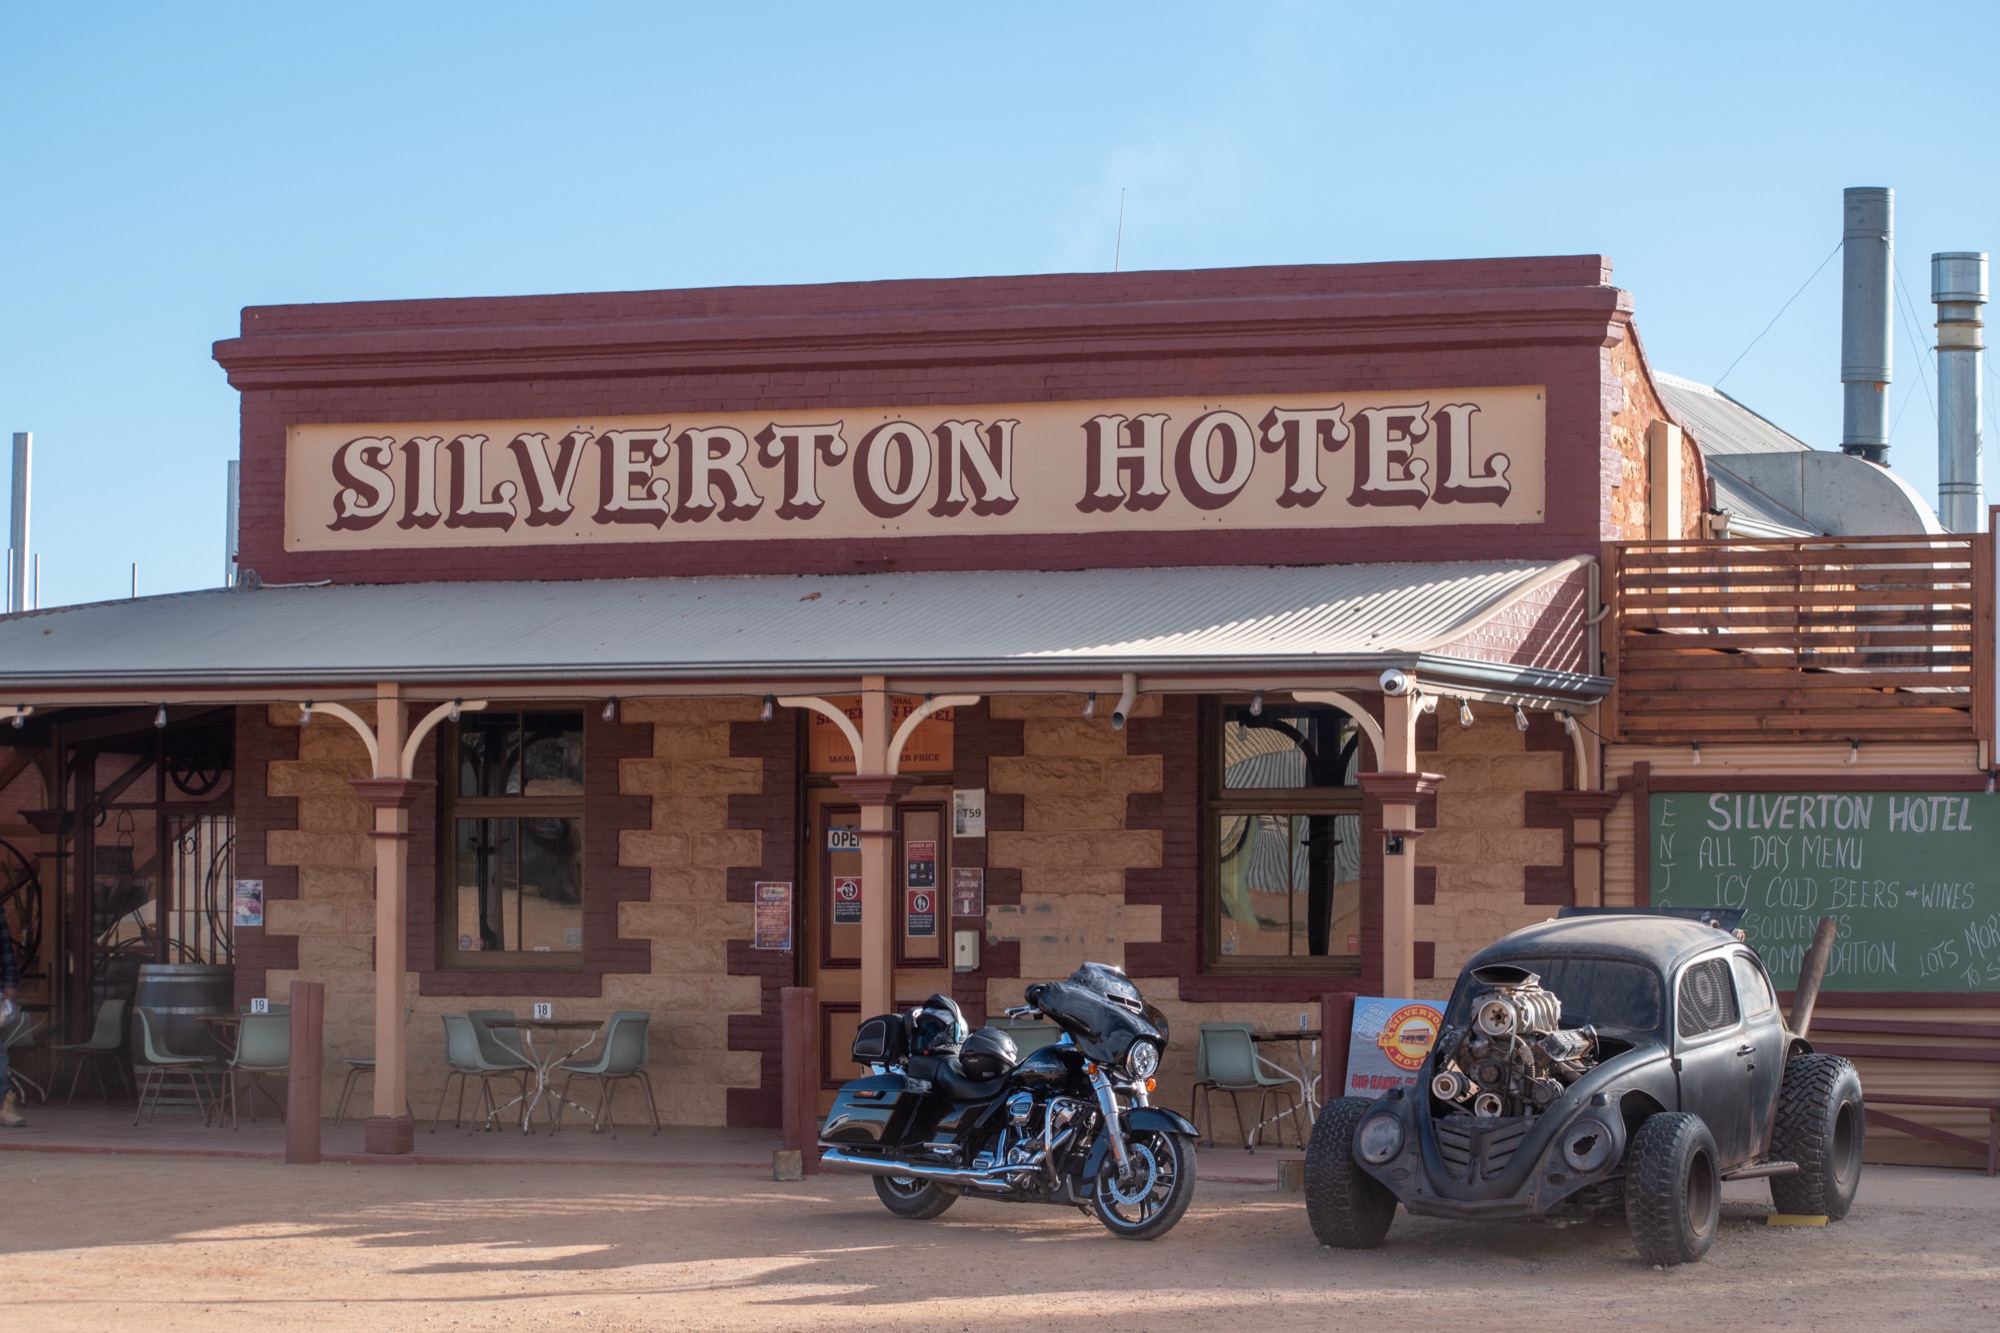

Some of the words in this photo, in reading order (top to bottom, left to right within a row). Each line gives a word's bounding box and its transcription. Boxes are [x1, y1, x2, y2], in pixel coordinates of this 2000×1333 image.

[326, 419, 1021, 532] SILVERTON
[1075, 402, 1510, 512] HOTEL
[902, 706, 953, 722] HEL
[913, 754, 940, 762] PRICE
[962, 808, 982, 818] T59
[1707, 793, 1873, 831] SILVERTON
[1889, 796, 1972, 832] HOTEL
[1657, 798, 1677, 908] ENJ
[1699, 836, 1738, 870] ALL
[1750, 835, 1793, 874] DAY
[1802, 835, 1863, 871] MENU
[1713, 873, 1752, 908] ICY
[1766, 875, 1818, 909] COLD
[1823, 876, 1900, 910] BEERS
[1922, 881, 1975, 910] WINES
[1744, 913, 1852, 941] SOUVENRS
[1919, 939, 1958, 978] LOTS
[1964, 911, 2000, 959] MOR
[1960, 962, 1980, 989] TO
[255, 999, 265, 1010] 19
[537, 1004, 548, 1015] 18
[1395, 1053, 1425, 1066] HOT
[1352, 1074, 1369, 1089] BIG
